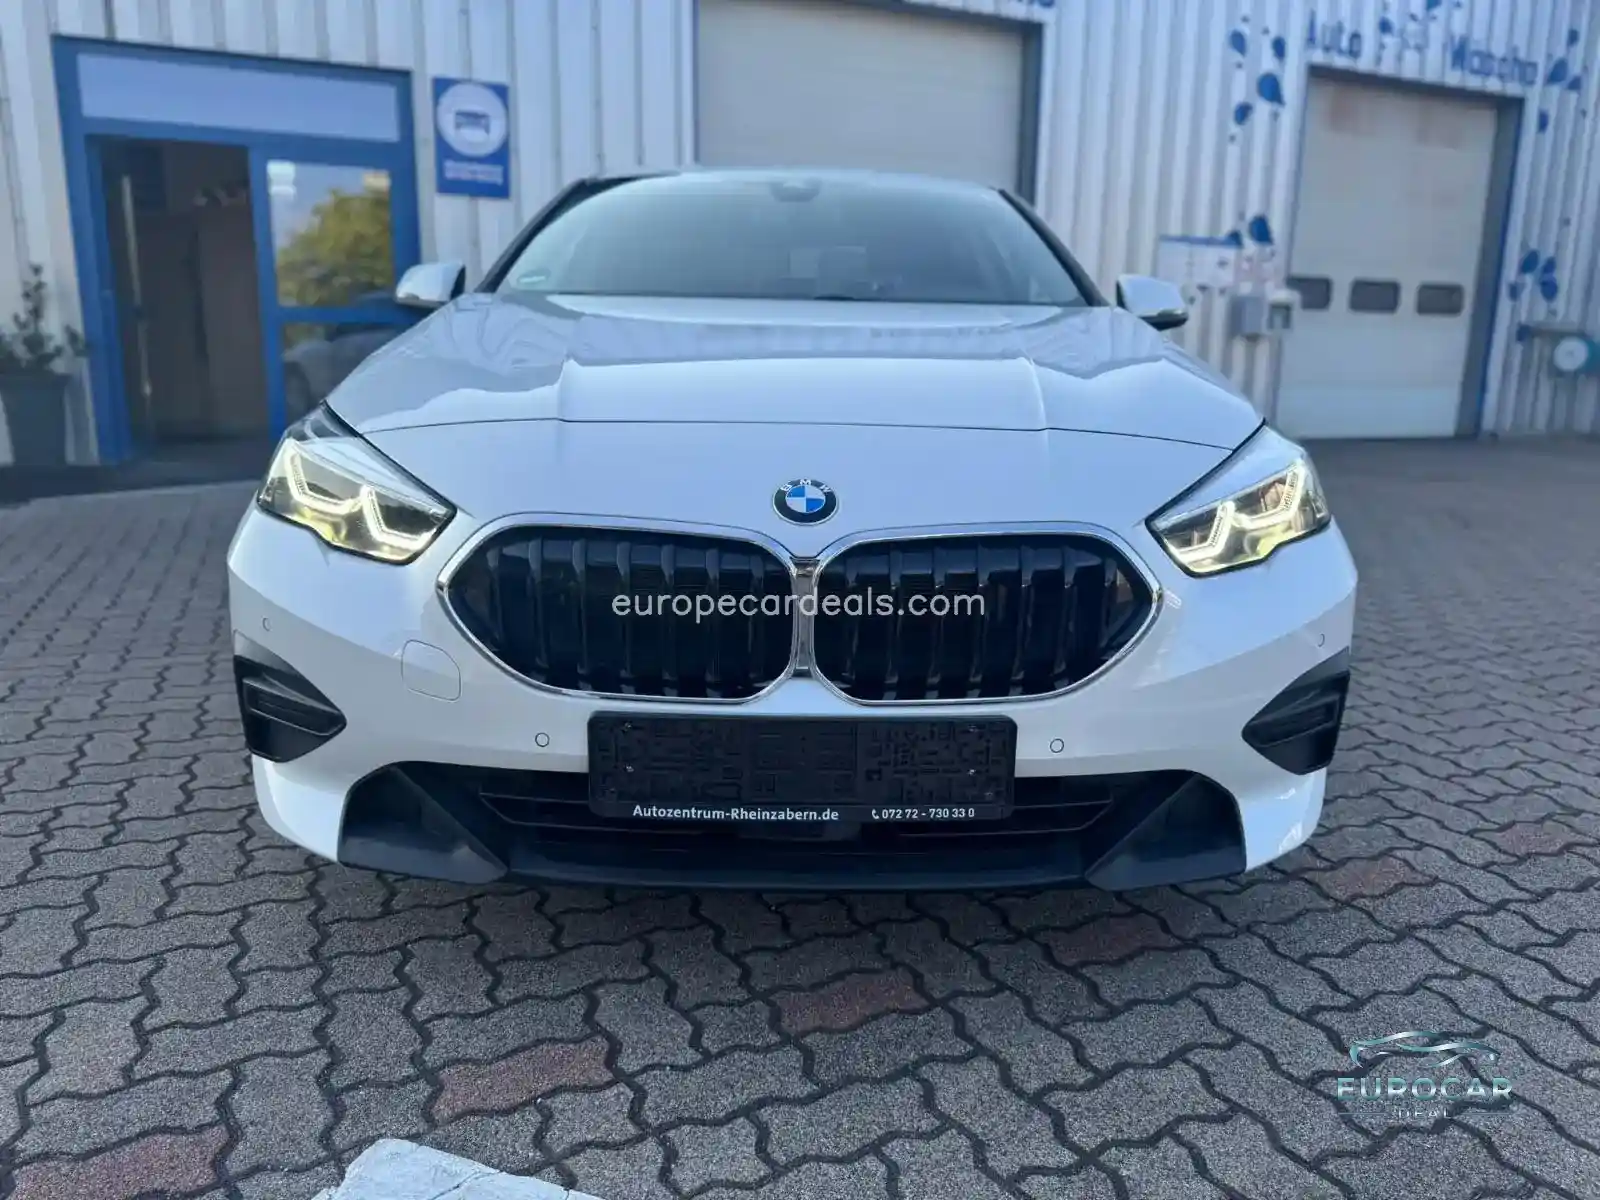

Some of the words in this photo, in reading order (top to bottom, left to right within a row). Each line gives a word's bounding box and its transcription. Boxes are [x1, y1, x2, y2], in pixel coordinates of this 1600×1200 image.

[632, 805, 839, 821] Autozentrum-Rheinzabern.de
[882, 809, 902, 819] 072
[905, 809, 918, 819] 72
[929, 808, 949, 818] 730
[952, 808, 965, 818] 33
